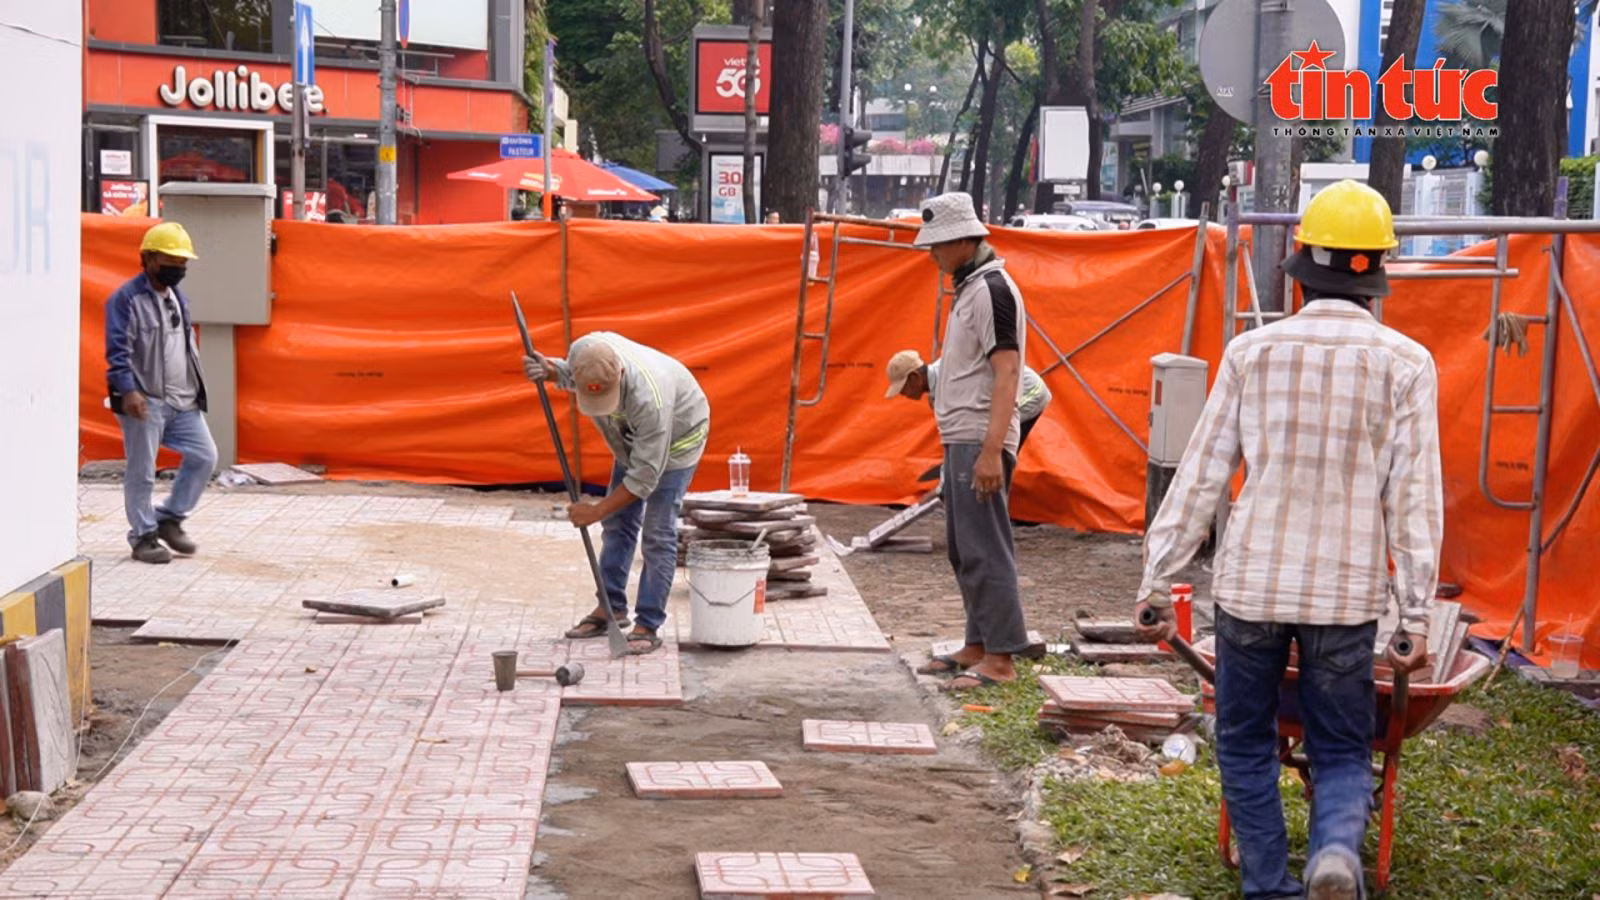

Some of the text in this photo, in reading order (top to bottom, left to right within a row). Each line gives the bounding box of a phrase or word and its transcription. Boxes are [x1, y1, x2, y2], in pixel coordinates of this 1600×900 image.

[723, 58, 760, 66] vietl
[160, 65, 324, 113] Jollibee
[718, 187, 736, 197] GB
